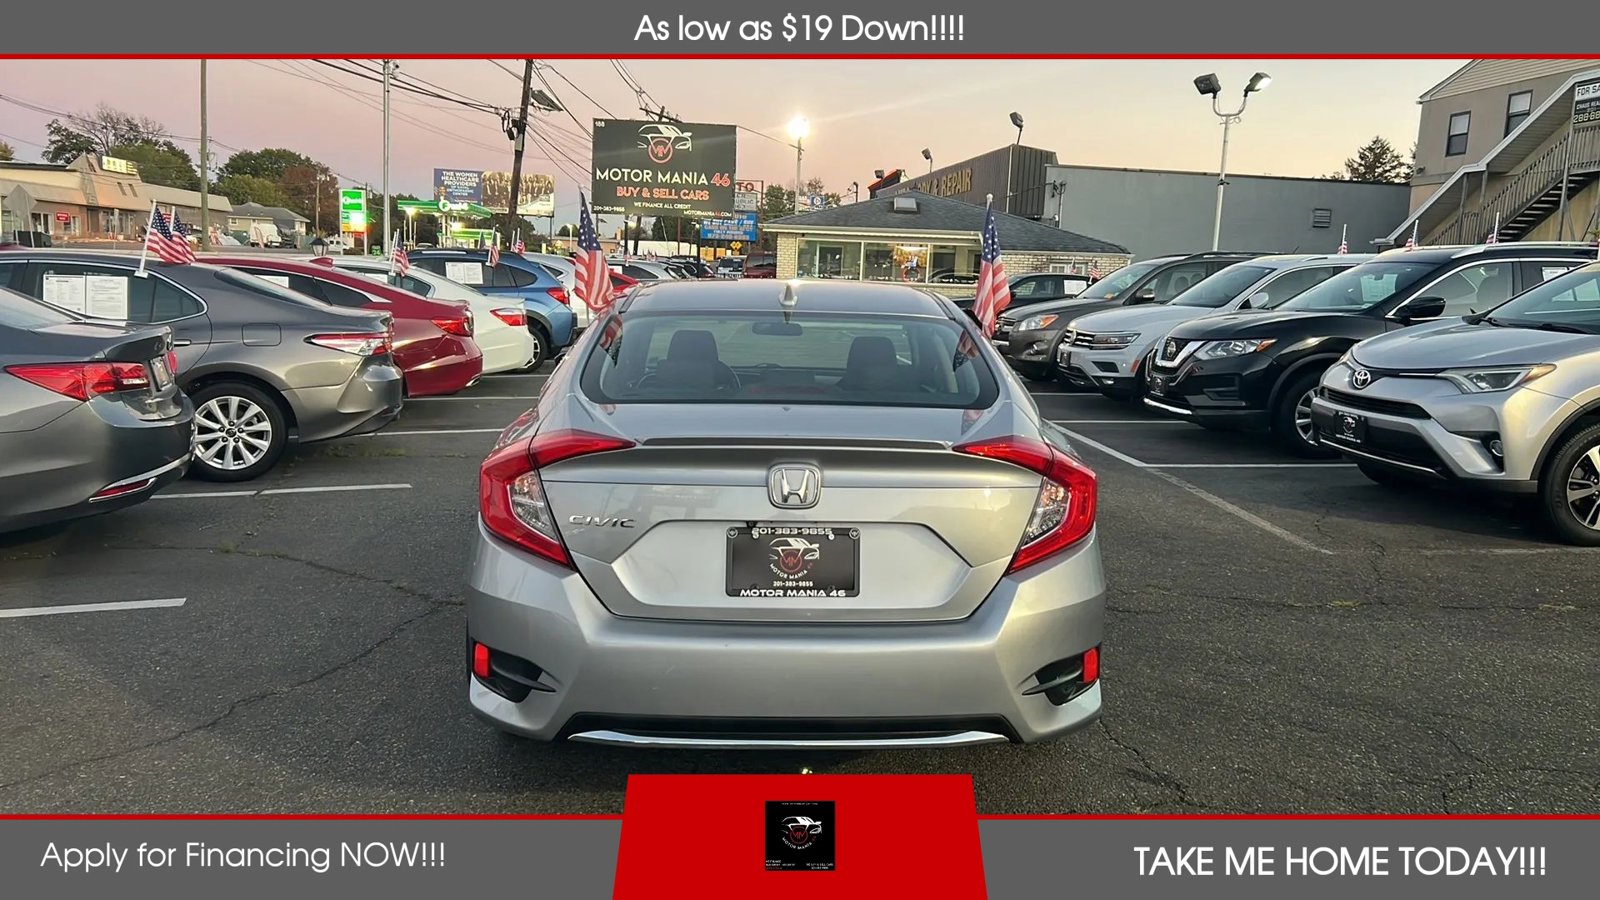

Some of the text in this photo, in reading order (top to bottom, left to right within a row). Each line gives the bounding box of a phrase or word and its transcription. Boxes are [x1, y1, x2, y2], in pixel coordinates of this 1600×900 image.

[1577, 87, 1590, 96] FOR
[596, 168, 731, 187] MOTOR MANIA 46
[941, 168, 973, 197] REPAIR
[616, 186, 710, 201] BUY & SELL CARS
[569, 515, 635, 528] CIVIC
[752, 527, 833, 535] 201-383-9855
[769, 563, 788, 579] MOTOR
[789, 570, 808, 579] MANIA
[740, 589, 846, 597] MOTOR MANIA 46
